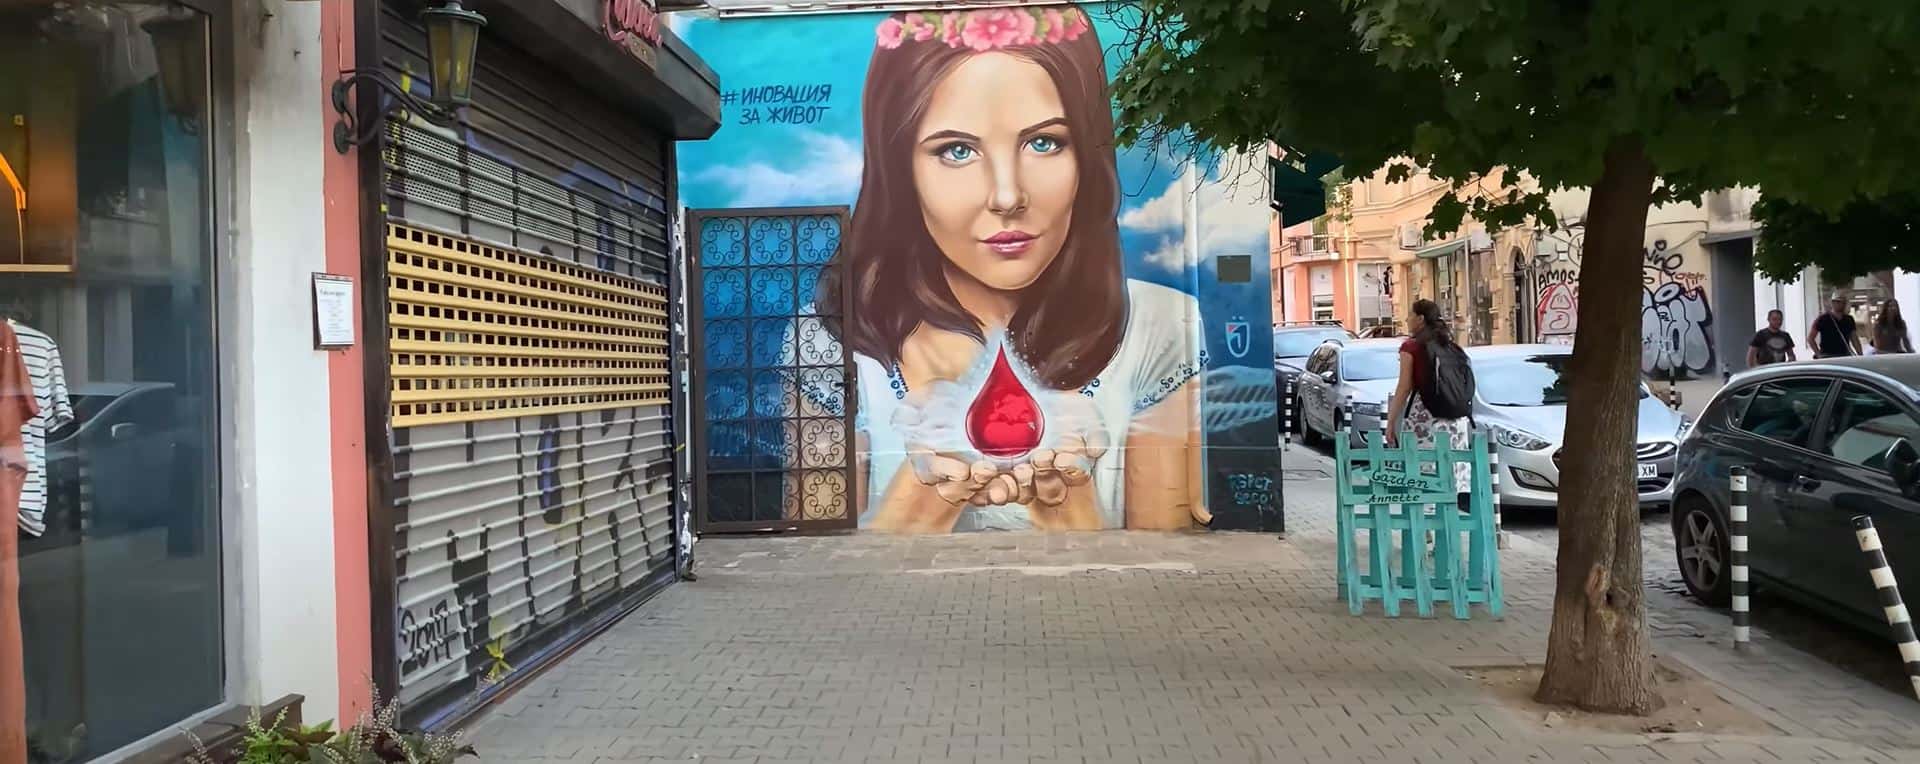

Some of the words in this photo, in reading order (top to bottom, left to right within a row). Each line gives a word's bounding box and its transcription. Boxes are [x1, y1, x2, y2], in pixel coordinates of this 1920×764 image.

[739, 108, 760, 125] ЗА
[766, 105, 831, 125] ЖИВОТ
[1372, 469, 1429, 489] Garden
[1367, 494, 1420, 503] Annette
